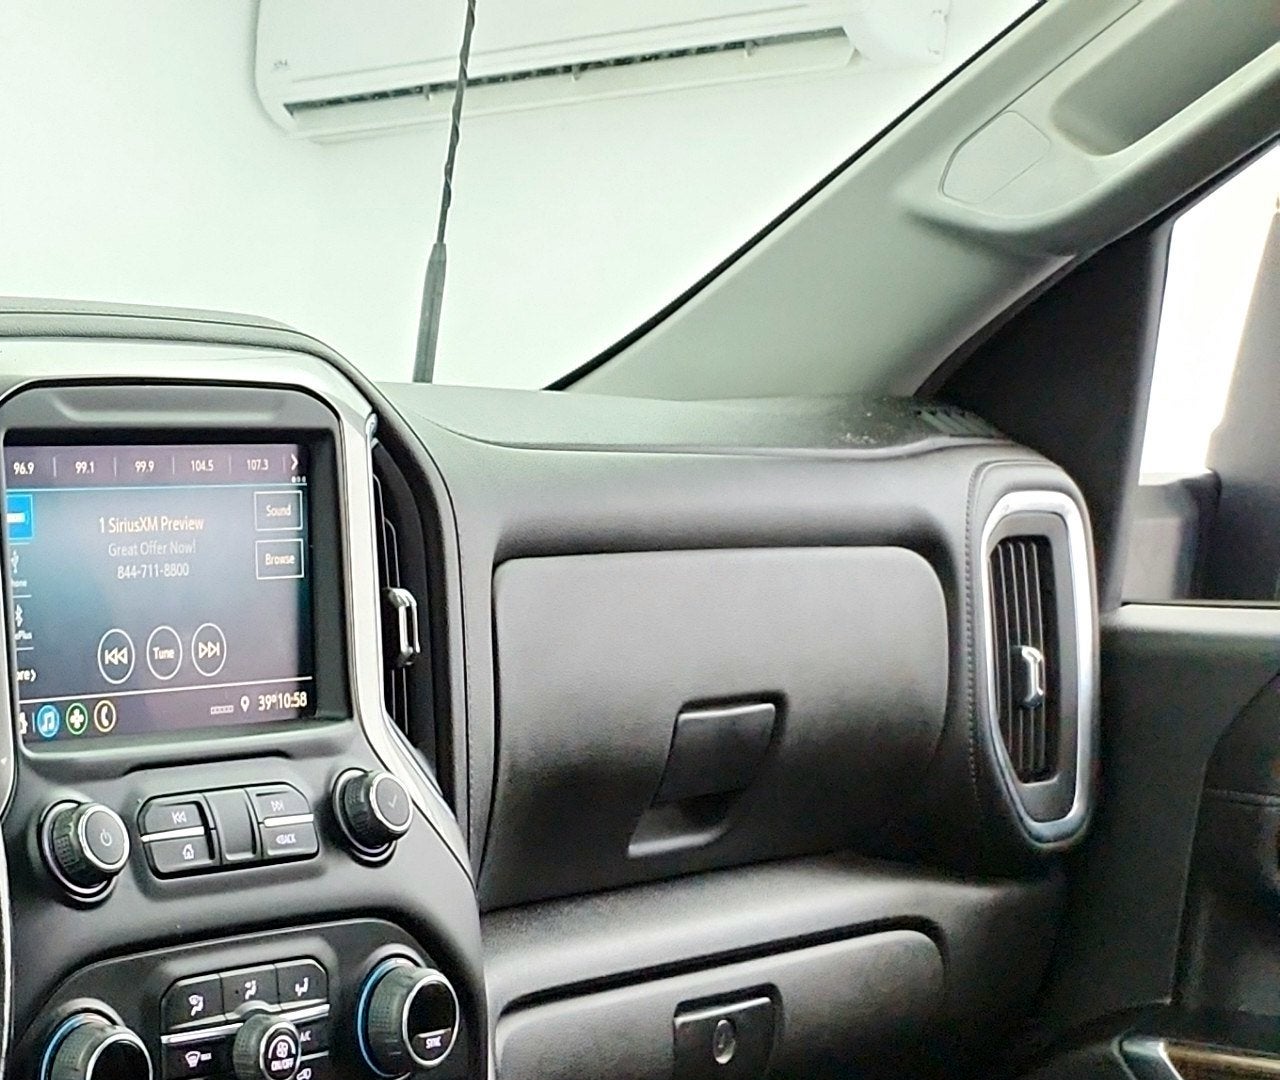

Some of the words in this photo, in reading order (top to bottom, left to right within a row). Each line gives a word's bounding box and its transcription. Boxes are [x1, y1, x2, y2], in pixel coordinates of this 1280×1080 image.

[13, 461, 35, 475] 96.9
[75, 461, 95, 474] 99.1
[134, 460, 155, 473] 99.9
[190, 459, 214, 472] 104.5
[246, 458, 269, 471] 107.3
[266, 504, 292, 517] Sound
[99, 516, 105, 533] 1
[108, 515, 158, 533] SiriusXM
[161, 515, 204, 531] Preview
[108, 543, 139, 557] Great
[140, 540, 167, 556] Offer
[169, 538, 197, 554] Now!
[265, 552, 295, 566] Browse
[117, 562, 190, 579] 844-711-8800
[152, 646, 175, 660] Tune
